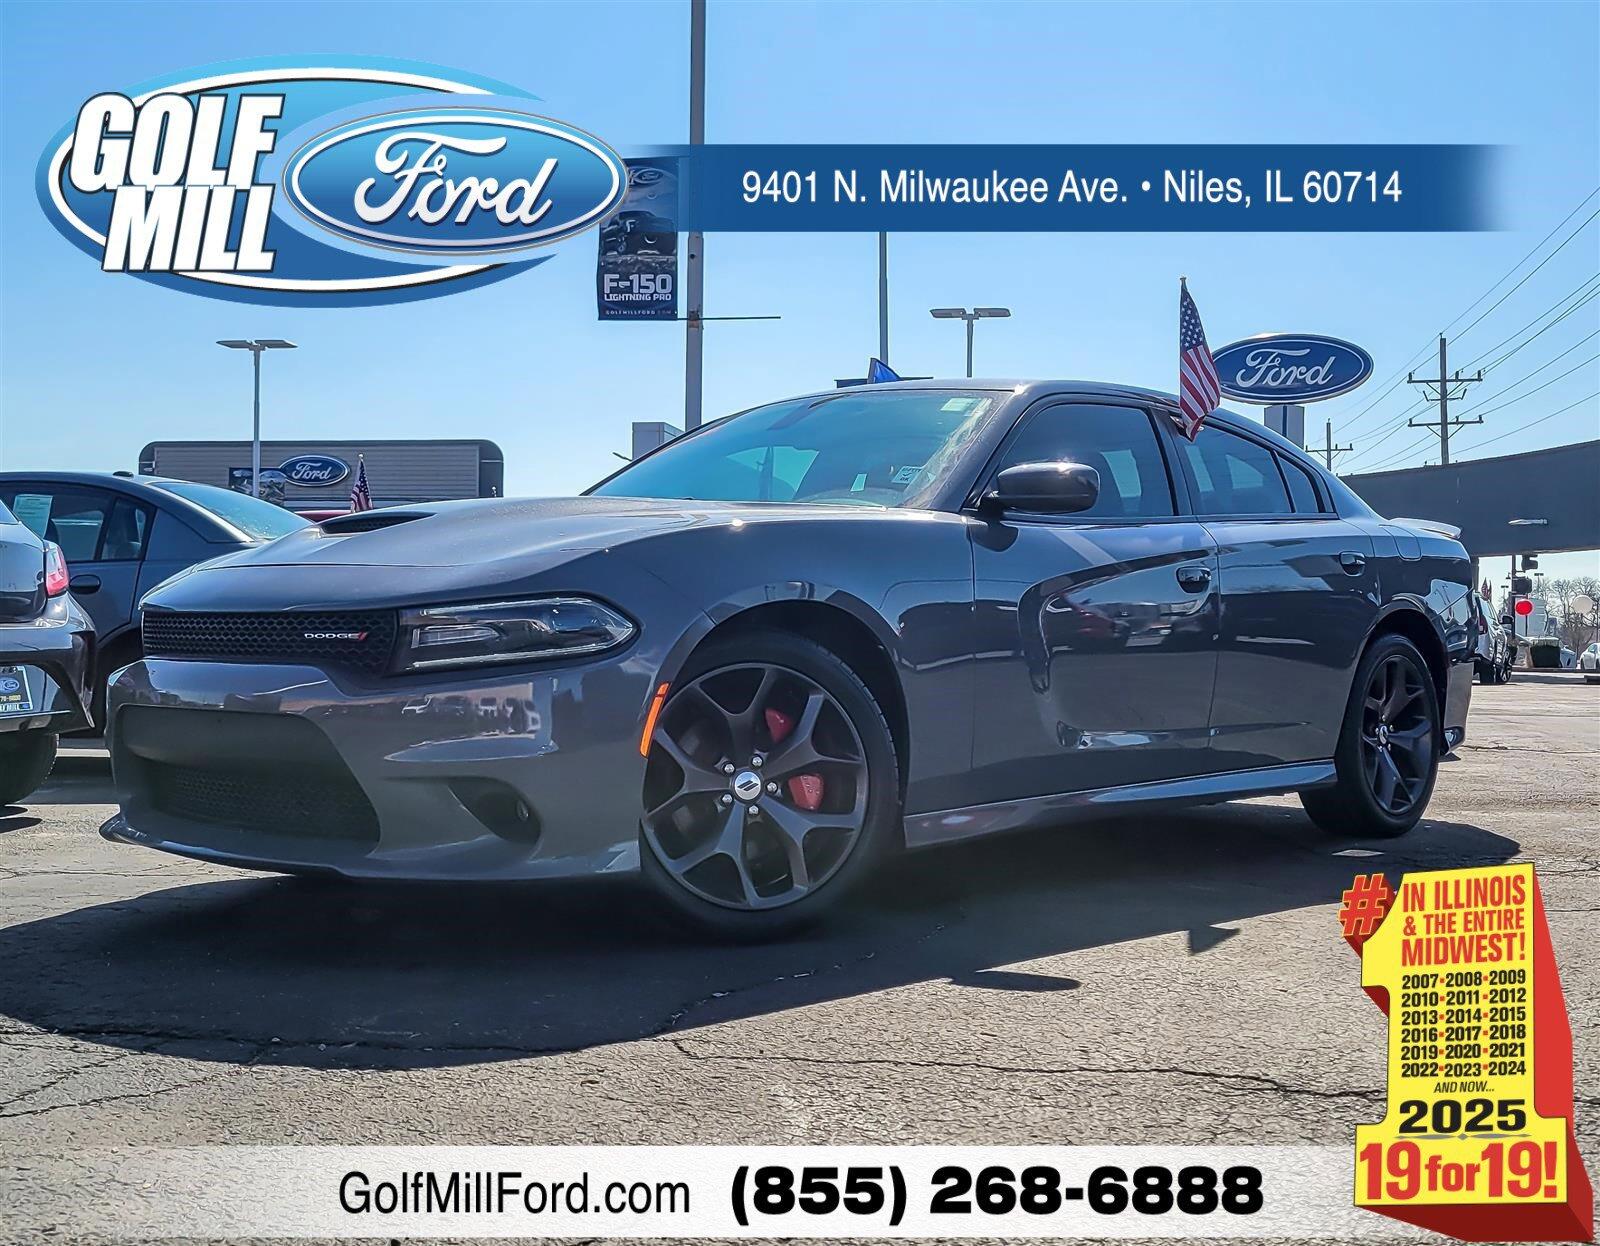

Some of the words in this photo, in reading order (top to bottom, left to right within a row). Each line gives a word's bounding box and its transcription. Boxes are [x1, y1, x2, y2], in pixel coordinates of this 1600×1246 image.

[603, 273, 673, 294] F-150
[604, 293, 652, 301] LIGHTNING
[652, 293, 672, 301] PRO
[1235, 348, 1337, 388] Ford
[291, 461, 332, 480] Ford
